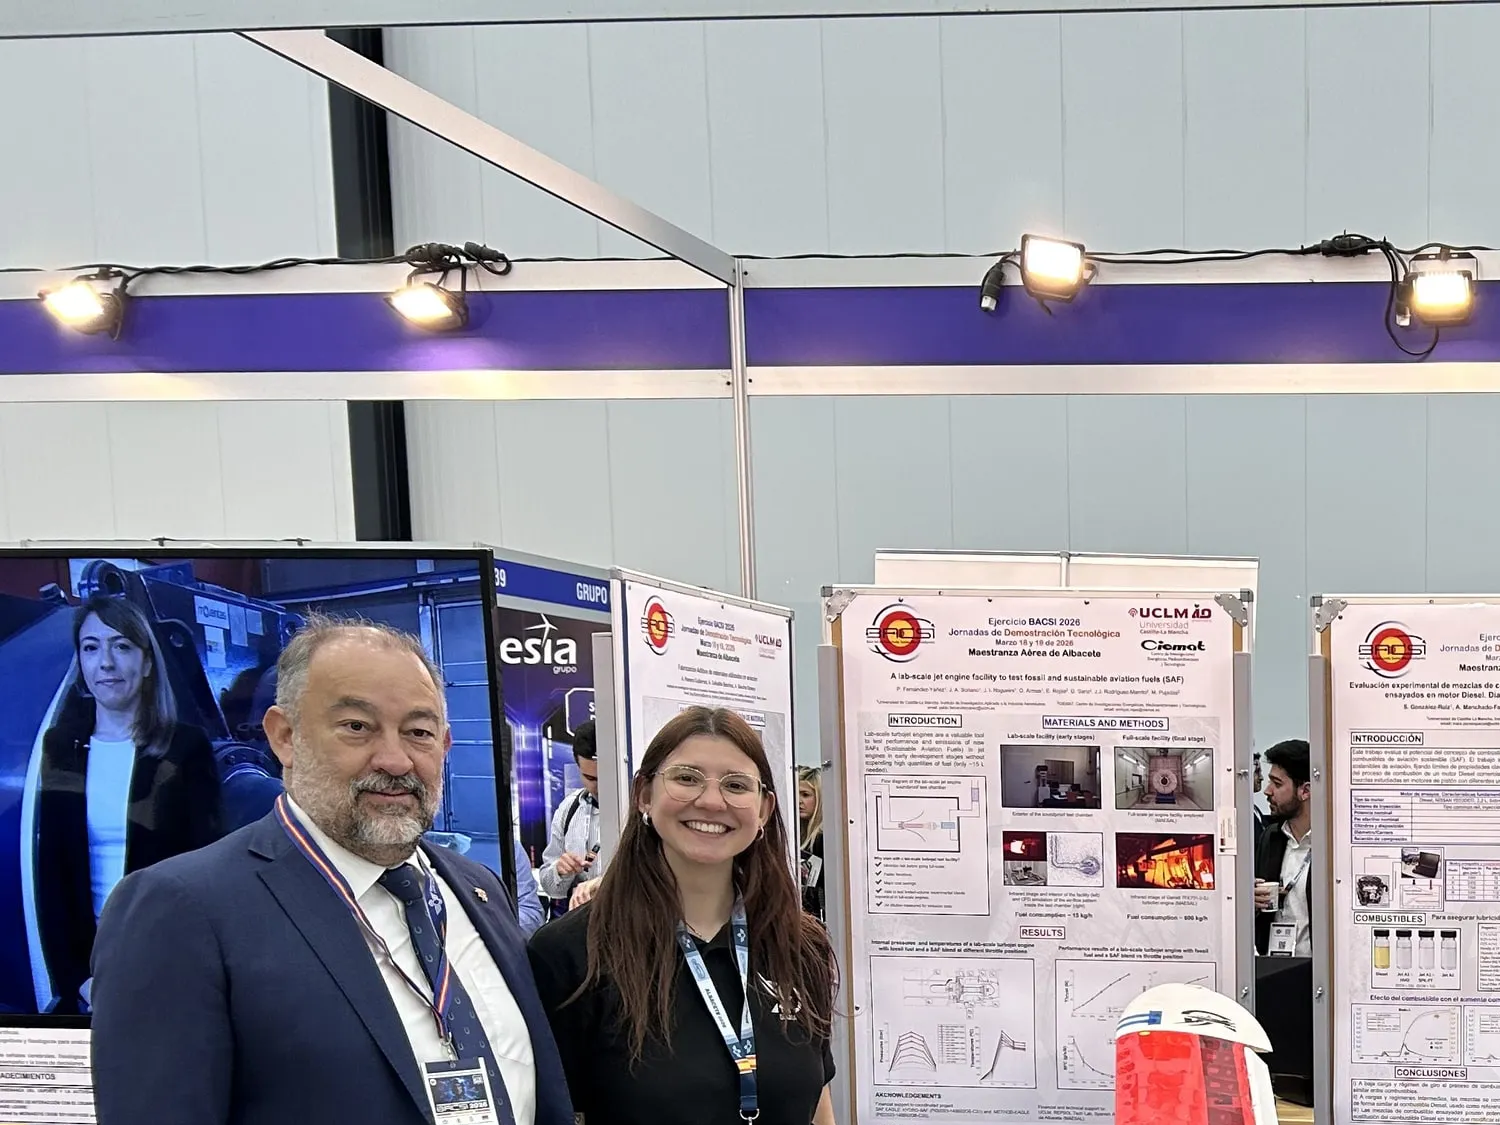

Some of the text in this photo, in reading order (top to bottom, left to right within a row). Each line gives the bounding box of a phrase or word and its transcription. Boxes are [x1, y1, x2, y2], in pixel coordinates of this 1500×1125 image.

[576, 583, 608, 605] GRUPO
[1139, 608, 1189, 619] UCLM
[989, 618, 1027, 627] Ejercicio
[1059, 618, 1081, 626] 2026
[1139, 621, 1189, 629] Universidad
[866, 628, 935, 639] BACSI
[1004, 629, 1066, 637] Demostración
[1068, 629, 1121, 639] Tecnológica
[758, 635, 776, 646] UCLM
[1141, 640, 1206, 651] Ciemat
[500, 636, 577, 665] esia
[968, 648, 1019, 656] Maestranza
[1062, 649, 1102, 657] Albacete
[1358, 644, 1426, 656] BACSI
[553, 665, 577, 675] grupo
[933, 674, 943, 682] jet
[944, 674, 971, 682] engine
[972, 674, 997, 682] facility
[1162, 676, 1185, 684] (SAF)
[890, 717, 957, 725] INTRODUCTION
[1044, 718, 1096, 727] MATERIALS
[1119, 720, 1164, 728] METHODS
[1352, 733, 1421, 743] INTRODUCCIÓN
[1355, 914, 1423, 923] COMBUSTIBLES
[1021, 928, 1063, 937] RESULTS
[704, 988, 720, 1016] ALBACETE
[1396, 1069, 1466, 1078] CONCLUSIONES
